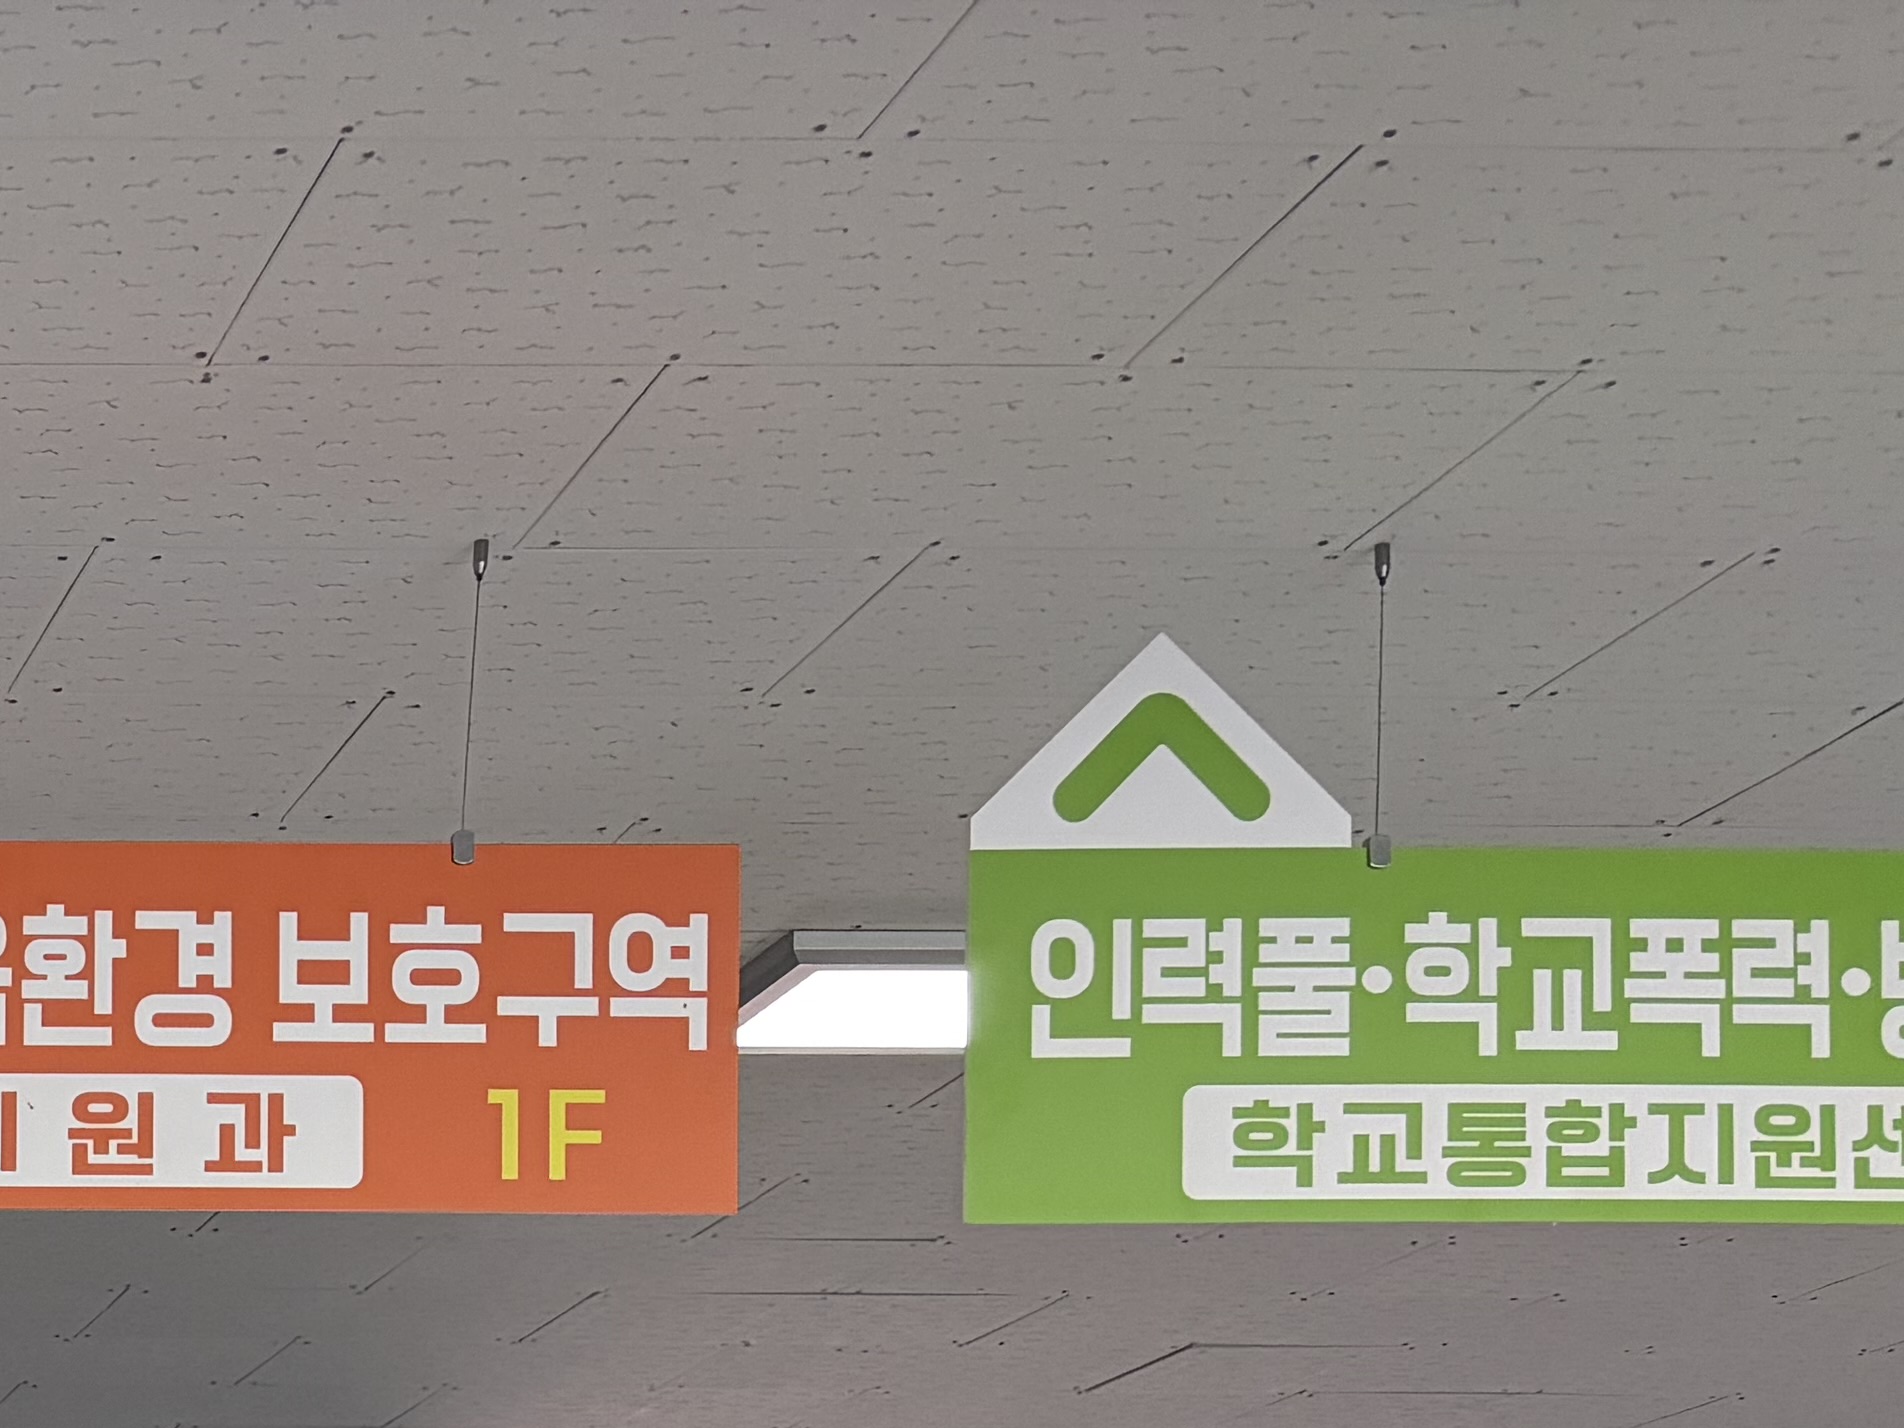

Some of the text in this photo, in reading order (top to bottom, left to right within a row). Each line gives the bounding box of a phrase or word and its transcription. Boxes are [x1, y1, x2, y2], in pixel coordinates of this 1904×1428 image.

[272, 905, 708, 1051] 보호구역
[1030, 911, 1904, 1058] 인력풀·학교폭력·
[487, 1089, 606, 1180] 1F
